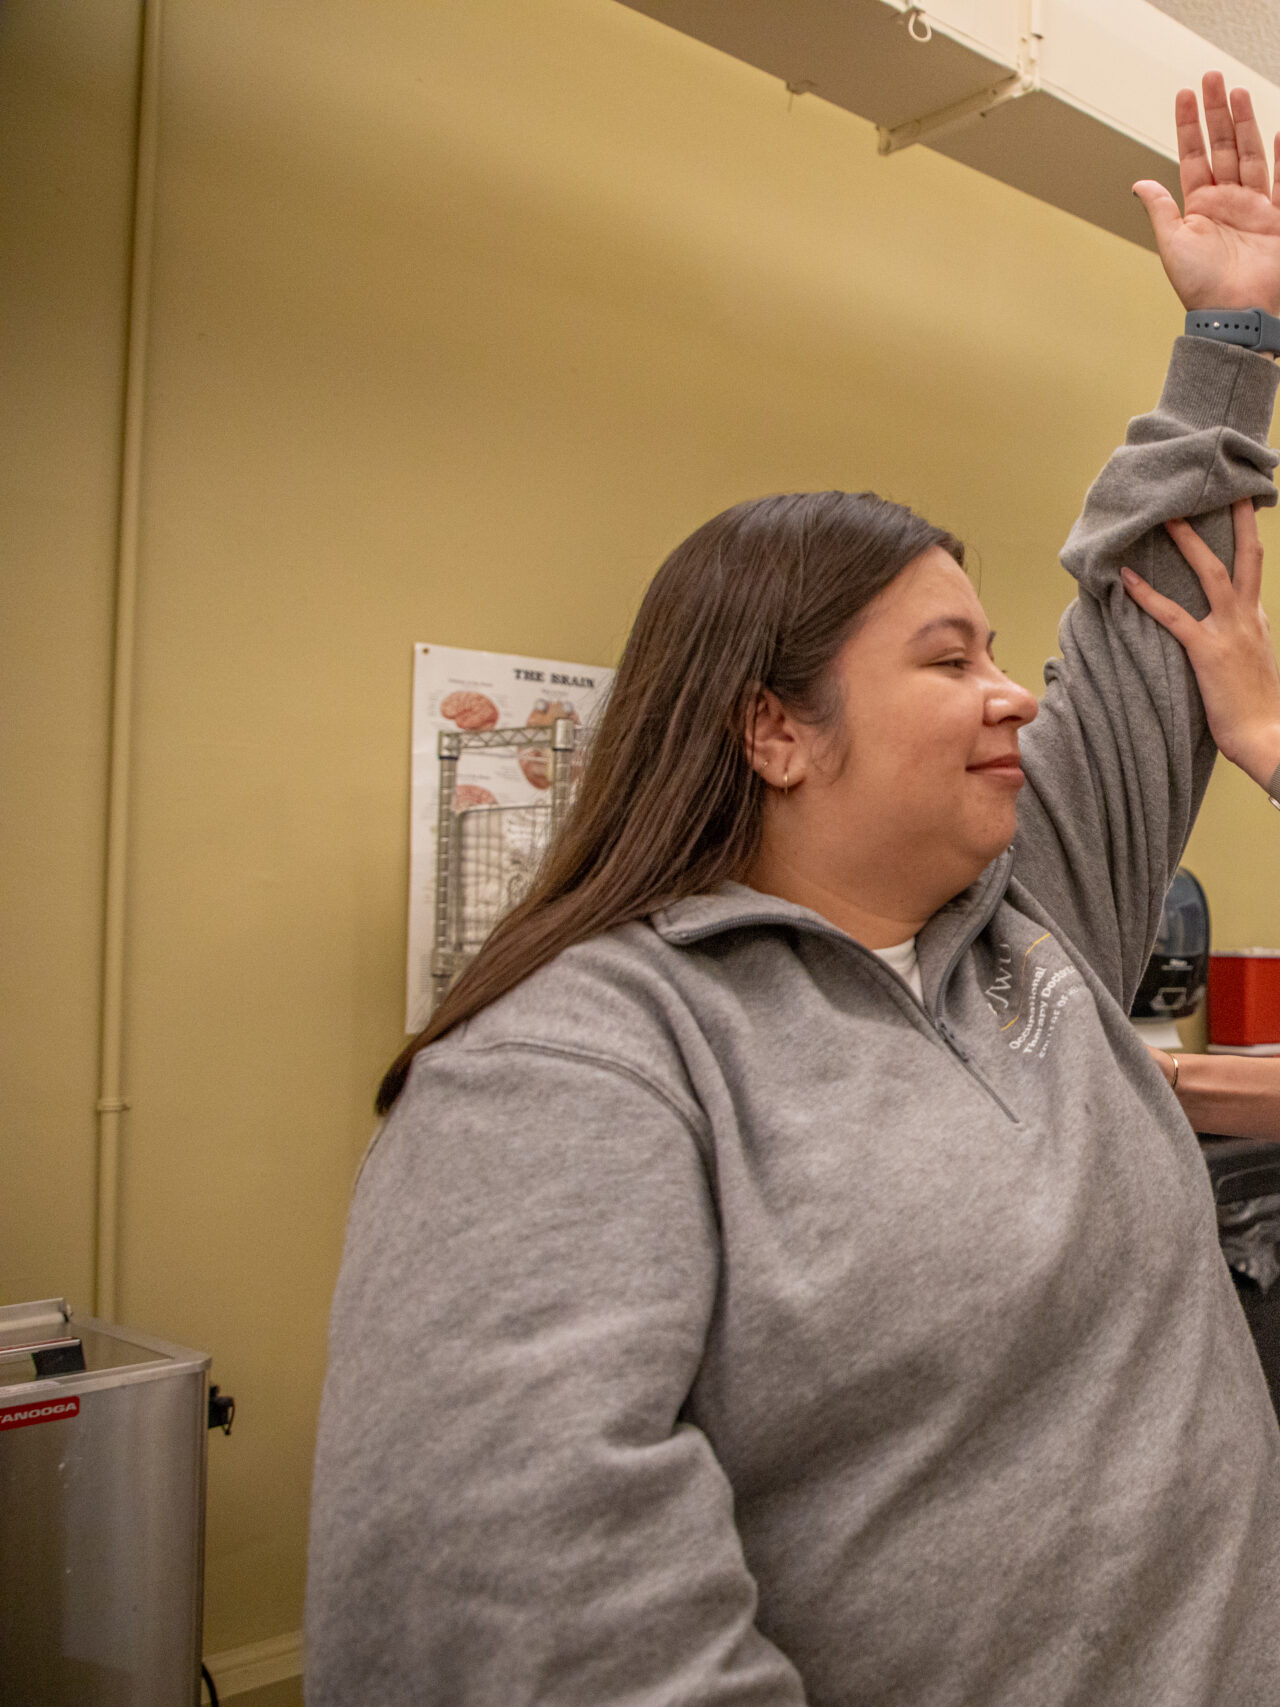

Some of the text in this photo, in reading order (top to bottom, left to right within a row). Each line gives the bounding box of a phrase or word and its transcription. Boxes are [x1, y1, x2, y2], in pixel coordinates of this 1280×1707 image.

[513, 668, 595, 688] THE BRAIN
[0, 1402, 77, 1424] ANOOGA
